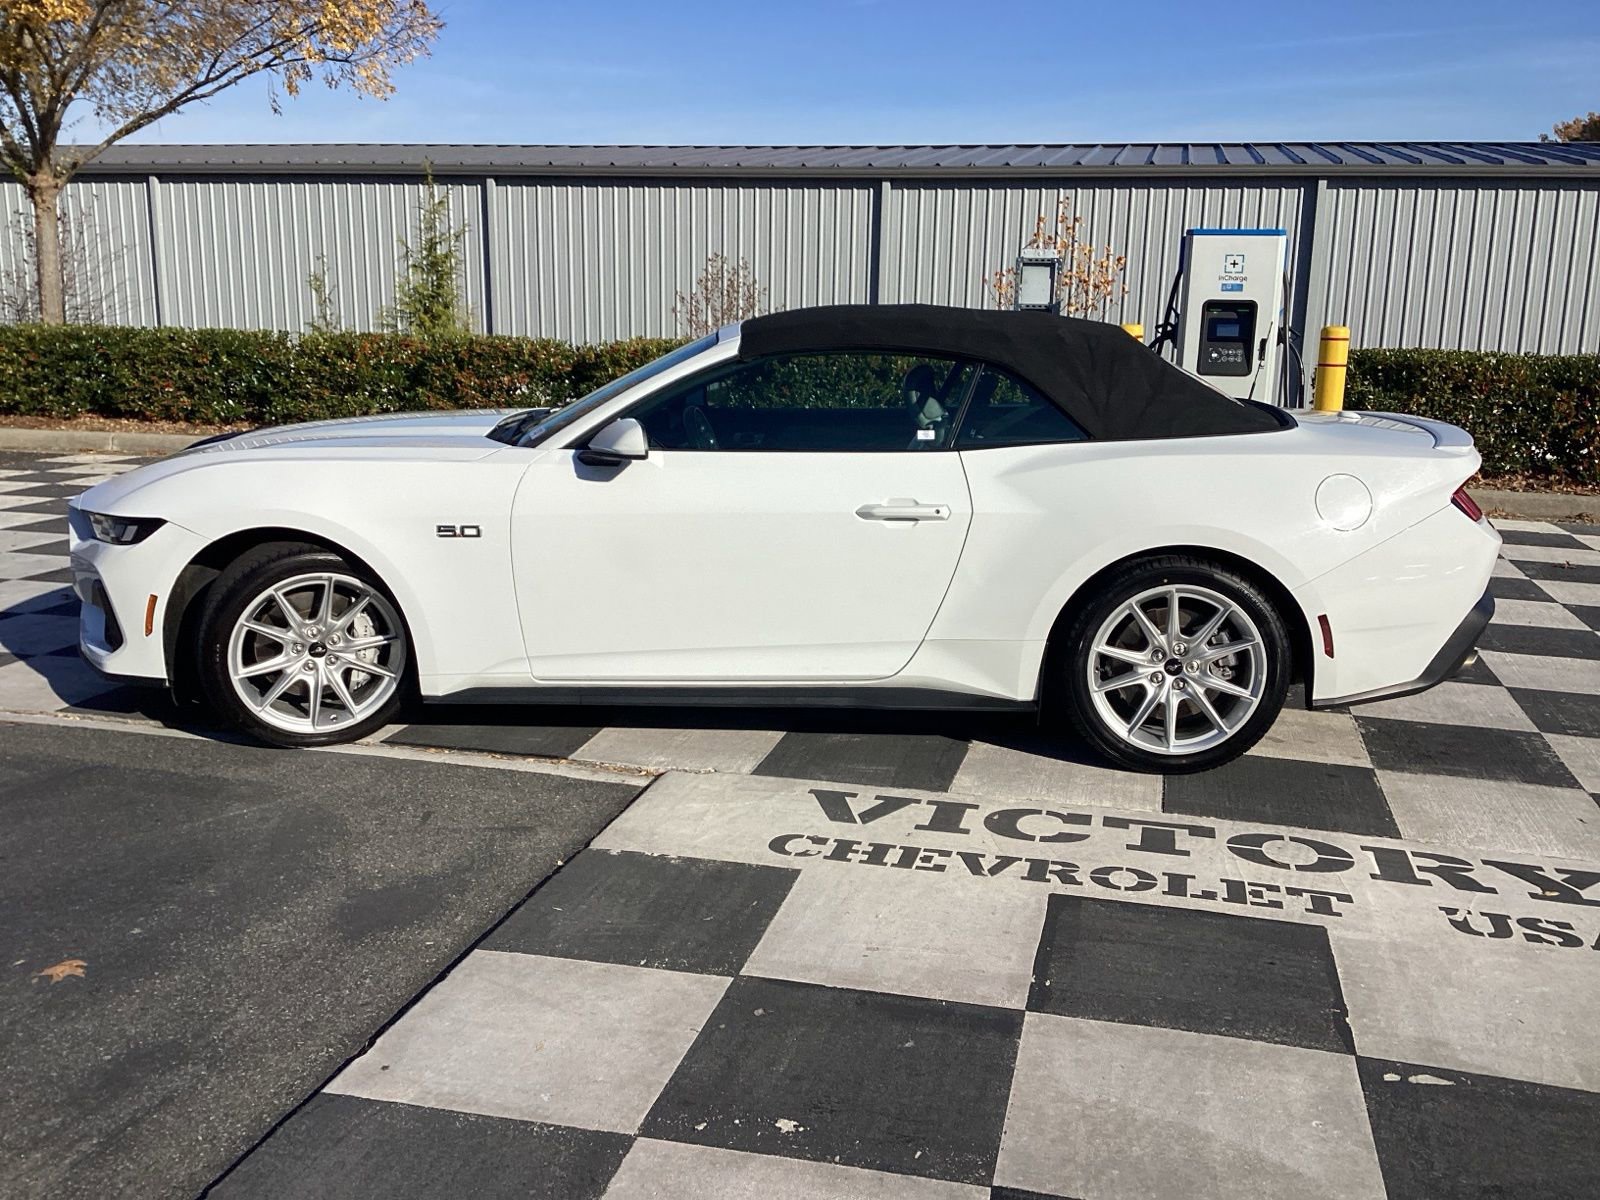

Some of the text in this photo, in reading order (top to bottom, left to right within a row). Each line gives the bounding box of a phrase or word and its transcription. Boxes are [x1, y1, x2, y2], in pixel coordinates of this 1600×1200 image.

[436, 525, 482, 538] 5.0
[768, 833, 1600, 951] CHEVROLET US
[808, 789, 1600, 907] VICTORY
